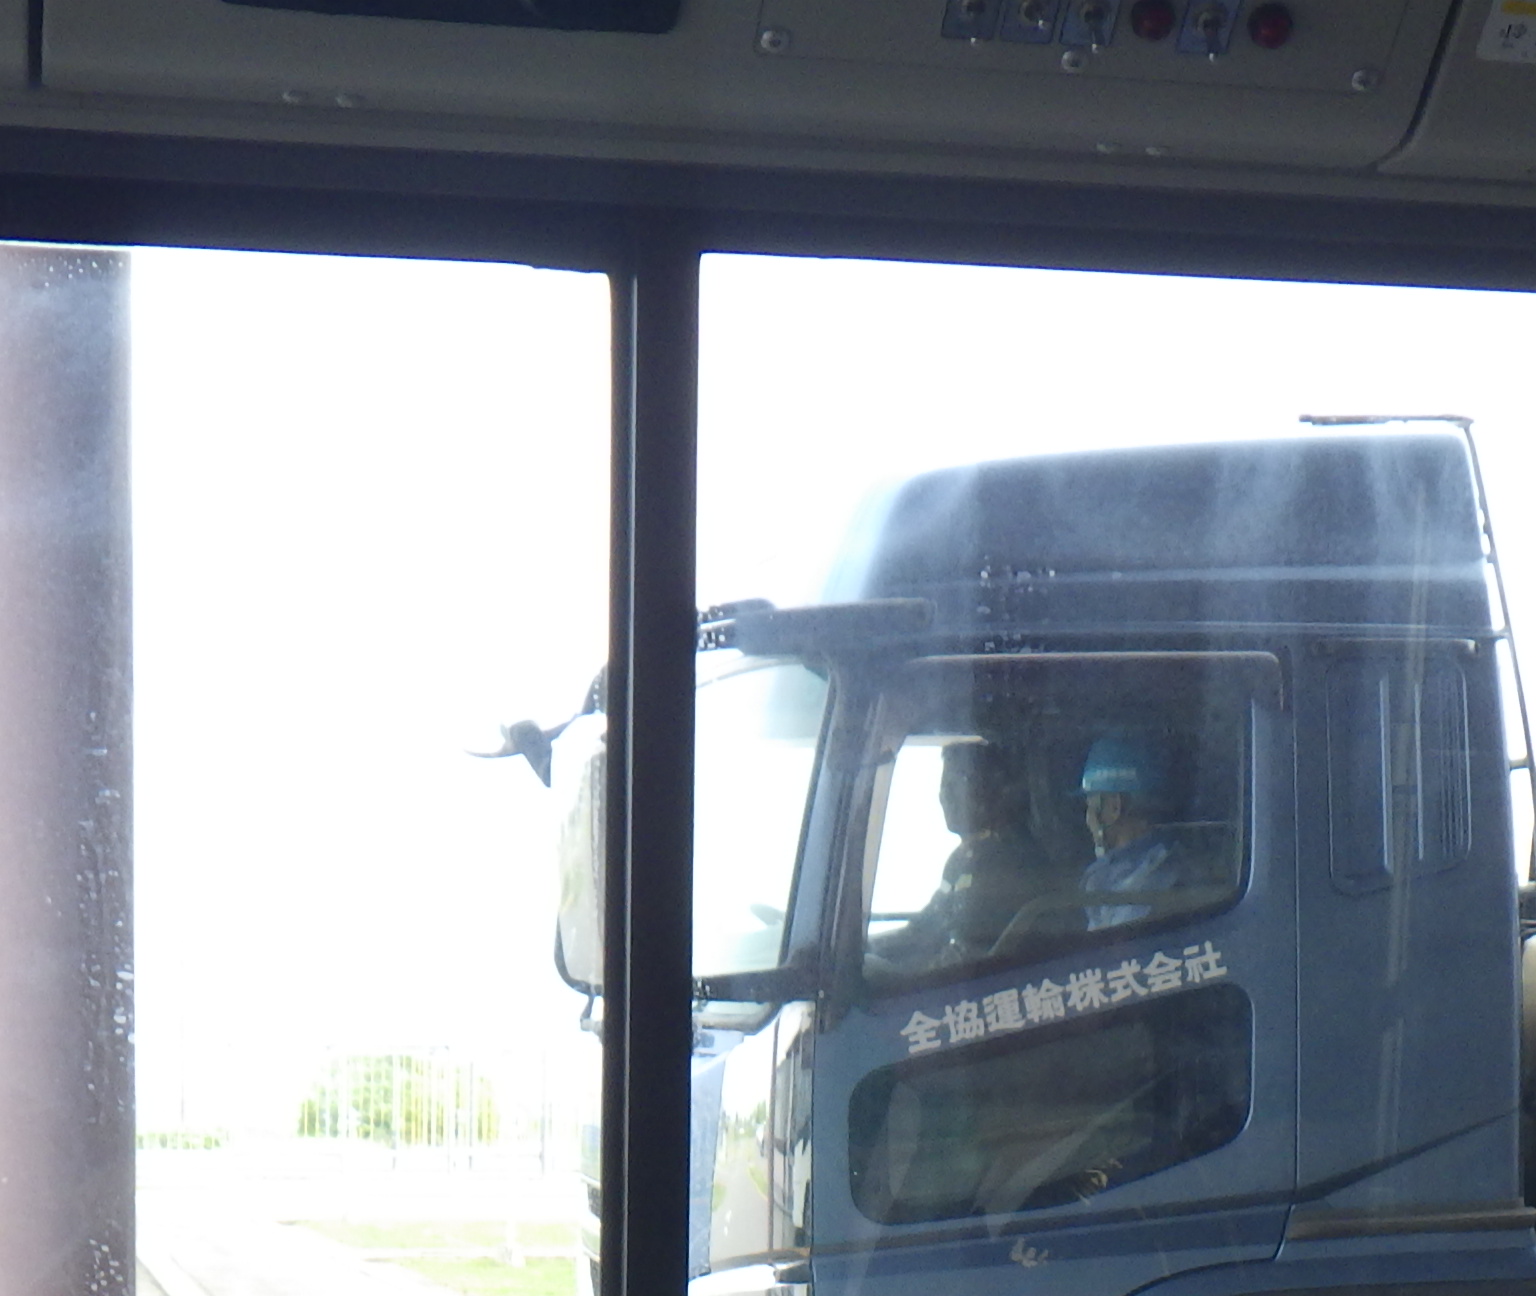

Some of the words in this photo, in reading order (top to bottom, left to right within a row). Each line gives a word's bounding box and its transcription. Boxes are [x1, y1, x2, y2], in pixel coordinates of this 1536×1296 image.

[900, 940, 1227, 1053] 全協運輸株式会社
